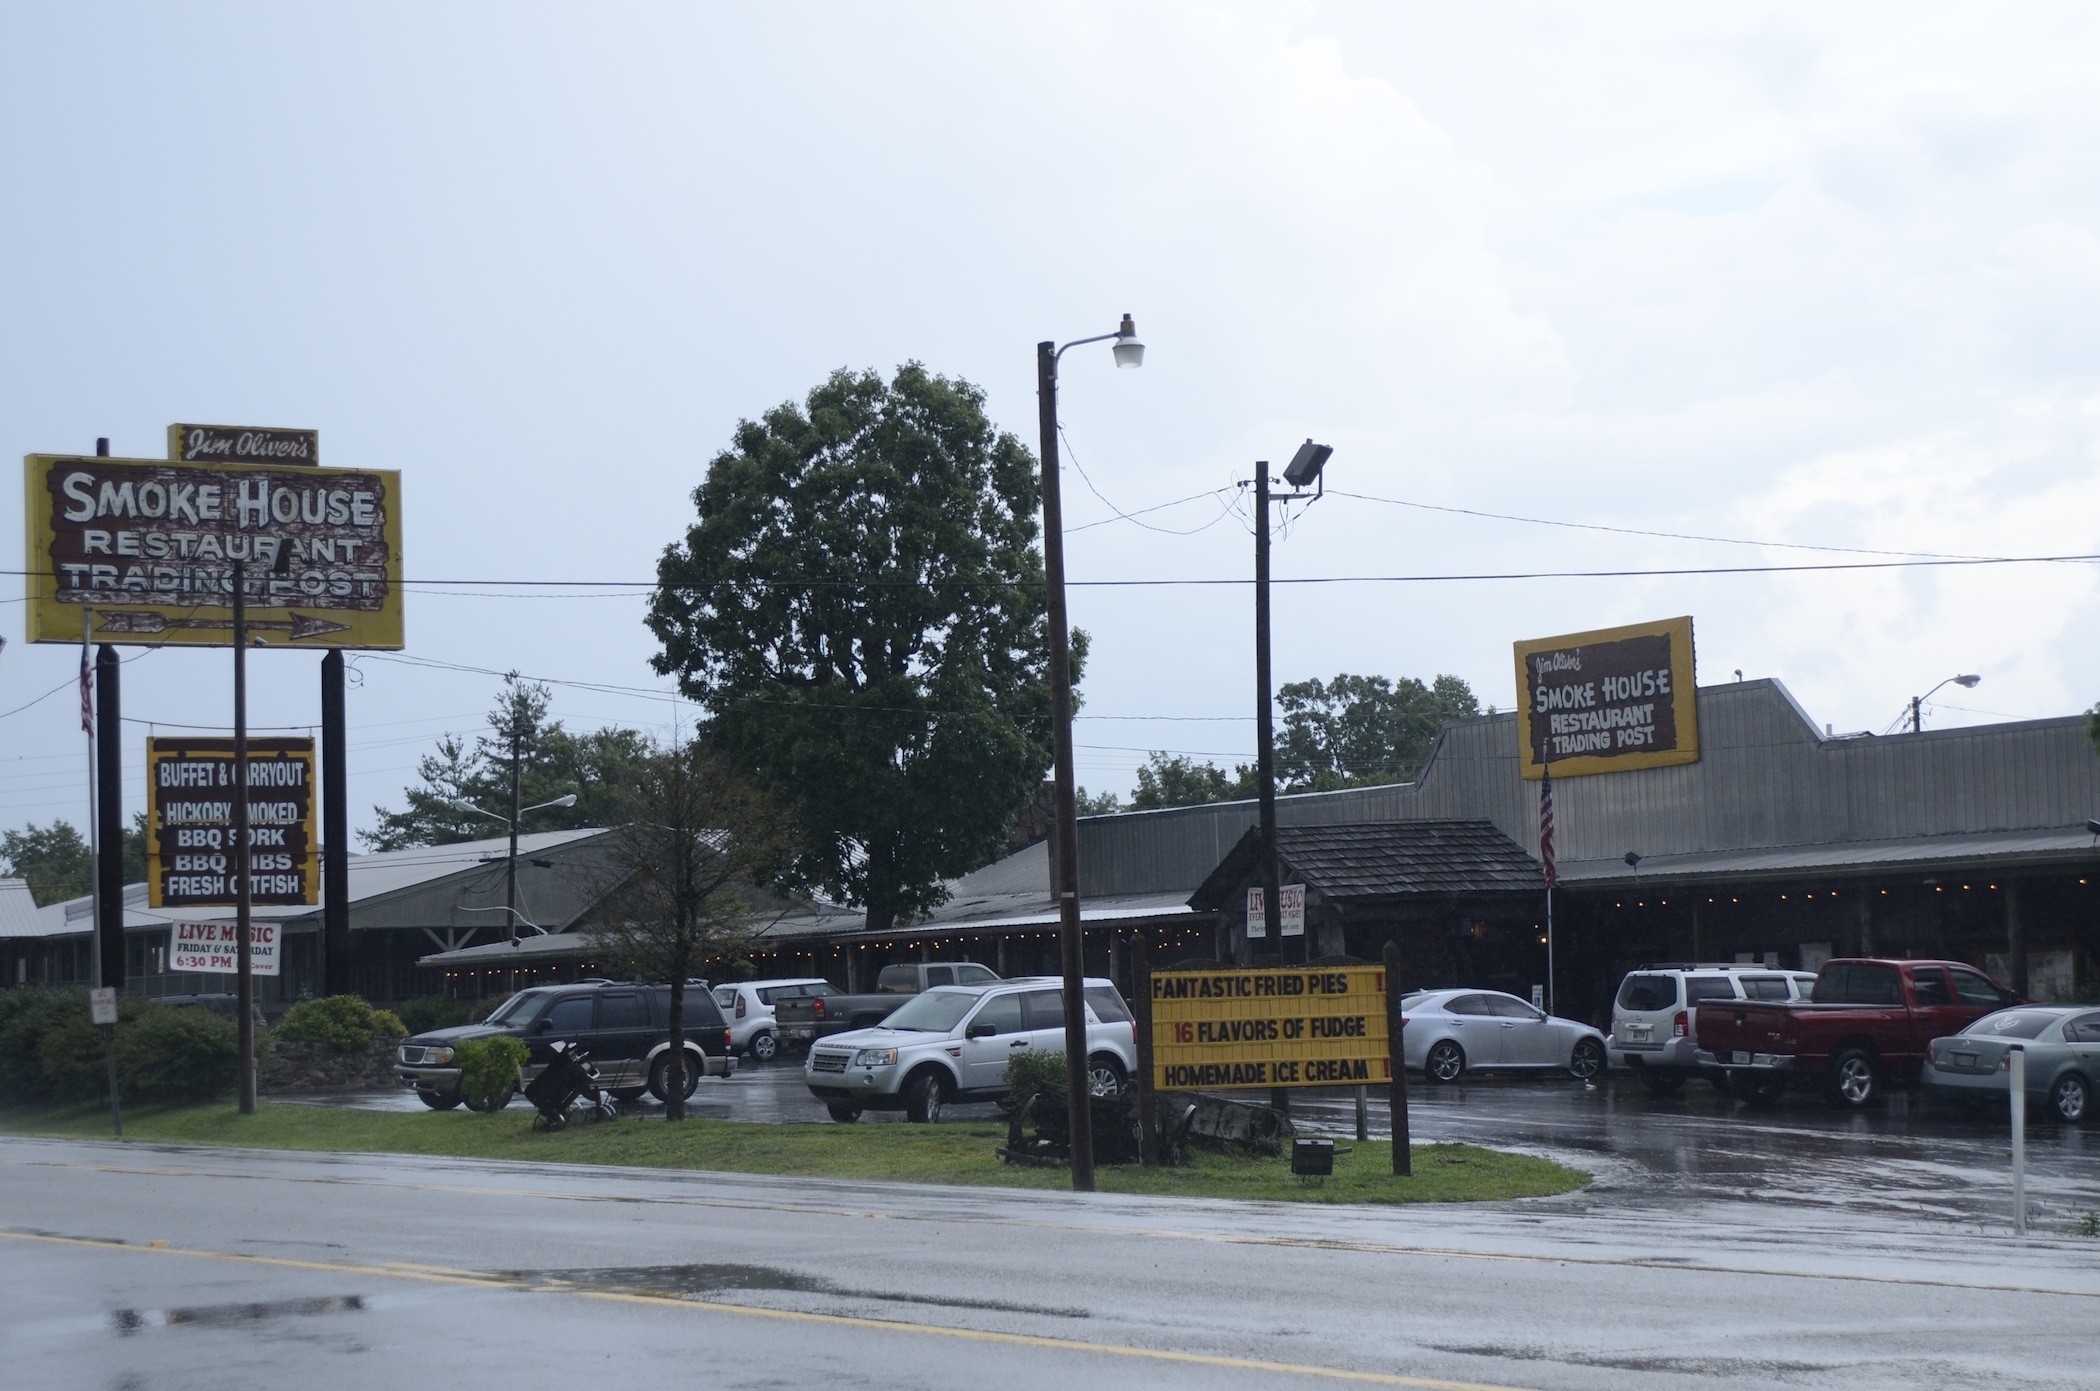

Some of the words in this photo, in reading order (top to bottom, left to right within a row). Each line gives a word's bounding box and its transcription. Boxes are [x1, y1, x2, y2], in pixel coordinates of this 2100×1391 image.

[186, 428, 233, 460] Jim
[236, 432, 308, 458] Oliver's
[63, 472, 222, 526] SMOKE
[237, 479, 376, 529] HOUSE
[84, 529, 363, 563] RESTAURANT
[1535, 656, 1553, 684] Jim
[1535, 682, 1596, 714] SMOKE
[1602, 668, 1671, 702] HOUSE
[1550, 703, 1654, 735] RESTAURANT
[1552, 731, 1611, 754] TRADING
[1616, 725, 1655, 748] POST
[160, 762, 215, 787] BUFFET
[219, 762, 228, 785] &
[231, 762, 304, 786] RRYOUT
[166, 802, 232, 826] HICKORY
[247, 802, 298, 825] MOKED
[178, 829, 222, 850] BBQ
[175, 853, 227, 874] BBQ
[235, 852, 293, 870] IBS
[168, 875, 225, 896] FRESH
[229, 874, 299, 895] CTFISH
[1280, 889, 1303, 909] USIC
[179, 923, 217, 941] LIVE
[177, 943, 212, 953] FRIDAY
[214, 944, 222, 953] &
[176, 955, 207, 967] 6:30
[210, 955, 233, 968] PM
[1152, 976, 1252, 998] FANTASTIC
[1255, 975, 1304, 996] FRIED
[1309, 973, 1348, 994] PIES
[1377, 972, 1383, 992] !
[1174, 1022, 1194, 1043] 16
[1198, 1019, 1279, 1042] FLAVORS
[1283, 1018, 1304, 1038] OF
[1311, 1016, 1366, 1038] FUDGE
[1164, 1063, 1267, 1086] HOMEMADE
[1272, 1062, 1300, 1082] ICE
[1305, 1059, 1369, 1081] CREAM
[1383, 1058, 1390, 1078] !
